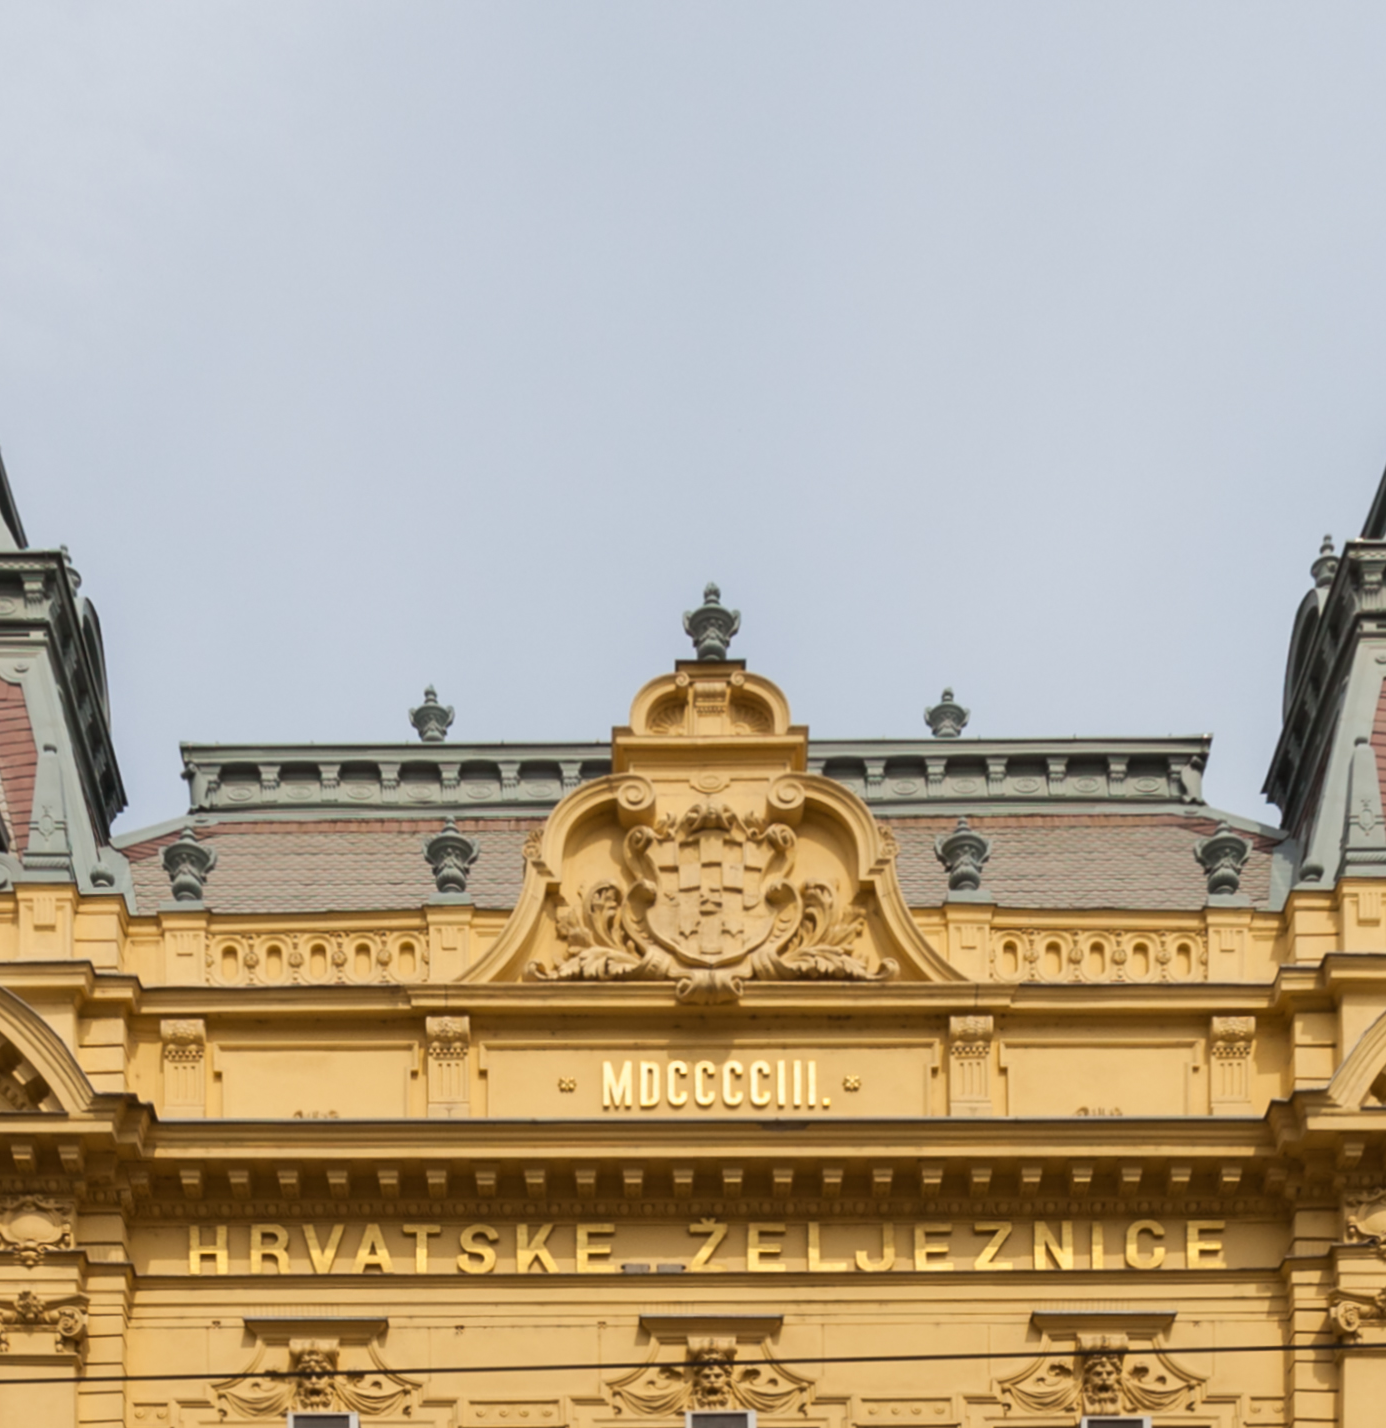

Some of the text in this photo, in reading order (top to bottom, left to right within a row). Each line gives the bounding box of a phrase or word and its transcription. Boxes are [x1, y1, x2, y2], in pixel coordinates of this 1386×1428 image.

[602, 1059, 832, 1108] MDCCCCIII.
[186, 1217, 1227, 1275] HRVATSKE ŽELJEZNICE
